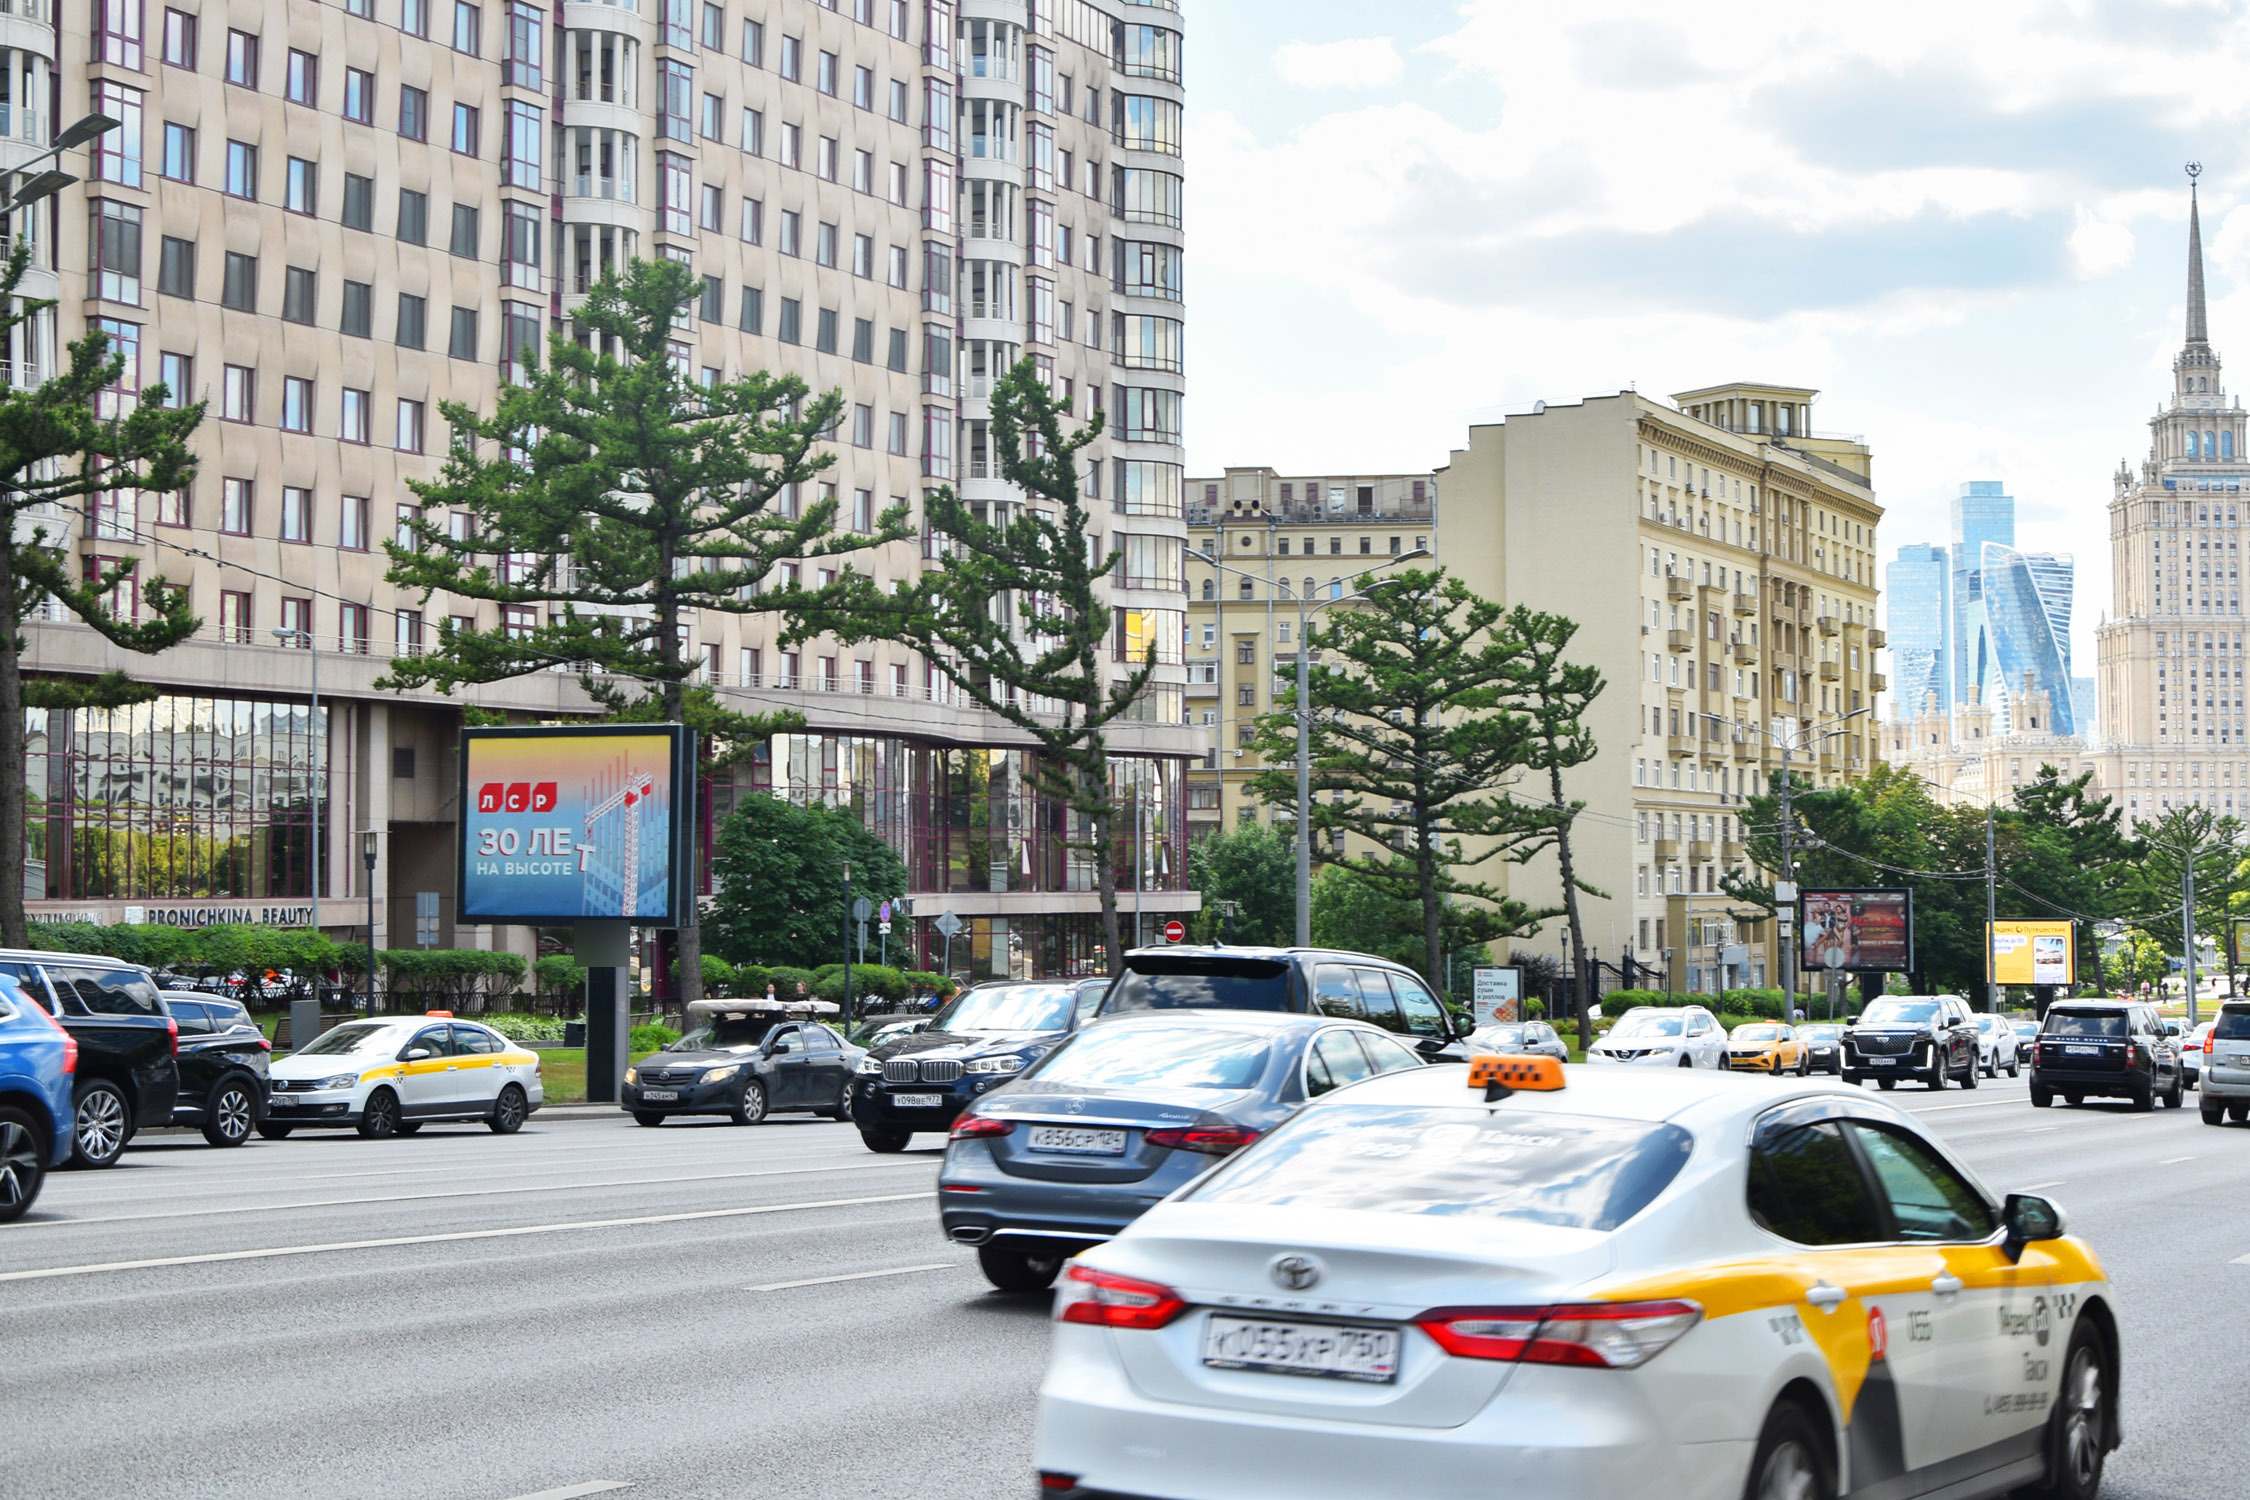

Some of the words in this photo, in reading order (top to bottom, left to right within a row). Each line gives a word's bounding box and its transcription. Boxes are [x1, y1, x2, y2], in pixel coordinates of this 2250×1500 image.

[478, 828, 520, 856] 30
[477, 862, 499, 875] НА
[504, 862, 572, 875] ВЫСОТЕ
